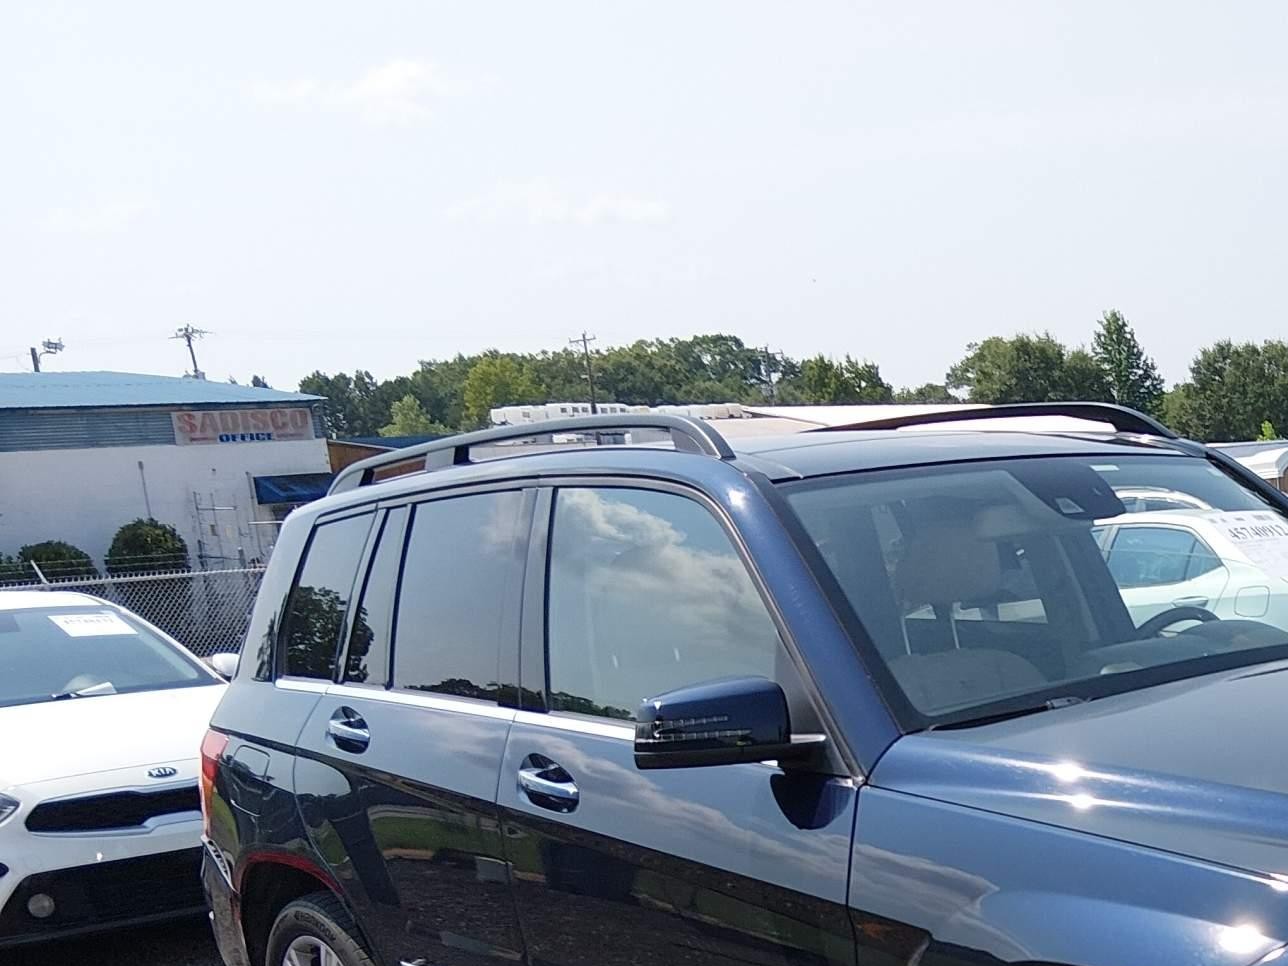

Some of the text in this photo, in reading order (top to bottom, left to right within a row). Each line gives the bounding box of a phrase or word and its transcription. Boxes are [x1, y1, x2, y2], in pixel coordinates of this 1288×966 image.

[177, 408, 308, 433] SADISCO
[219, 432, 273, 442] OFFICE
[150, 767, 175, 777] KIA
